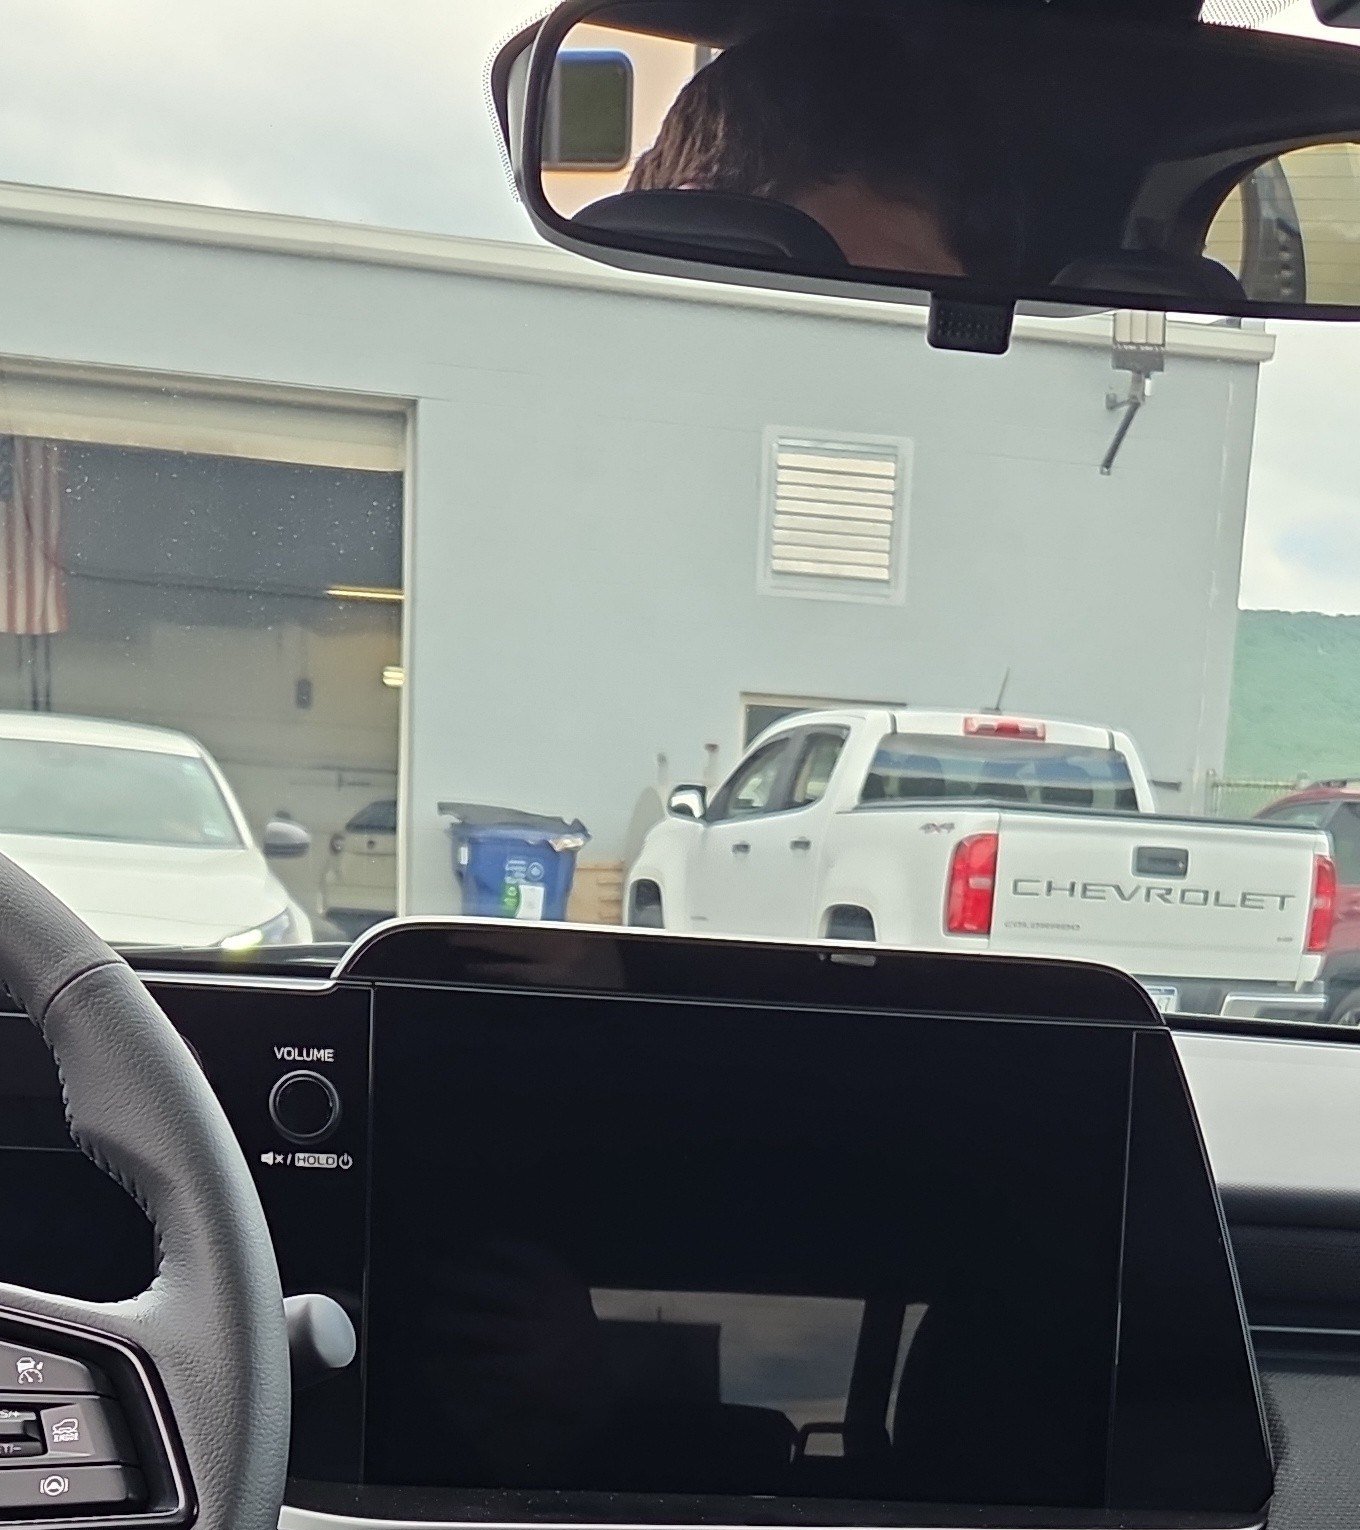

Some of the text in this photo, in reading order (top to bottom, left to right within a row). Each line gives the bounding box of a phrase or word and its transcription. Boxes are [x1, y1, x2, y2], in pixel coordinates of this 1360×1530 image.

[1012, 878, 1296, 911] CHEVROLET
[274, 1046, 335, 1063] VOLUME
[296, 1154, 337, 1167] HOLD
